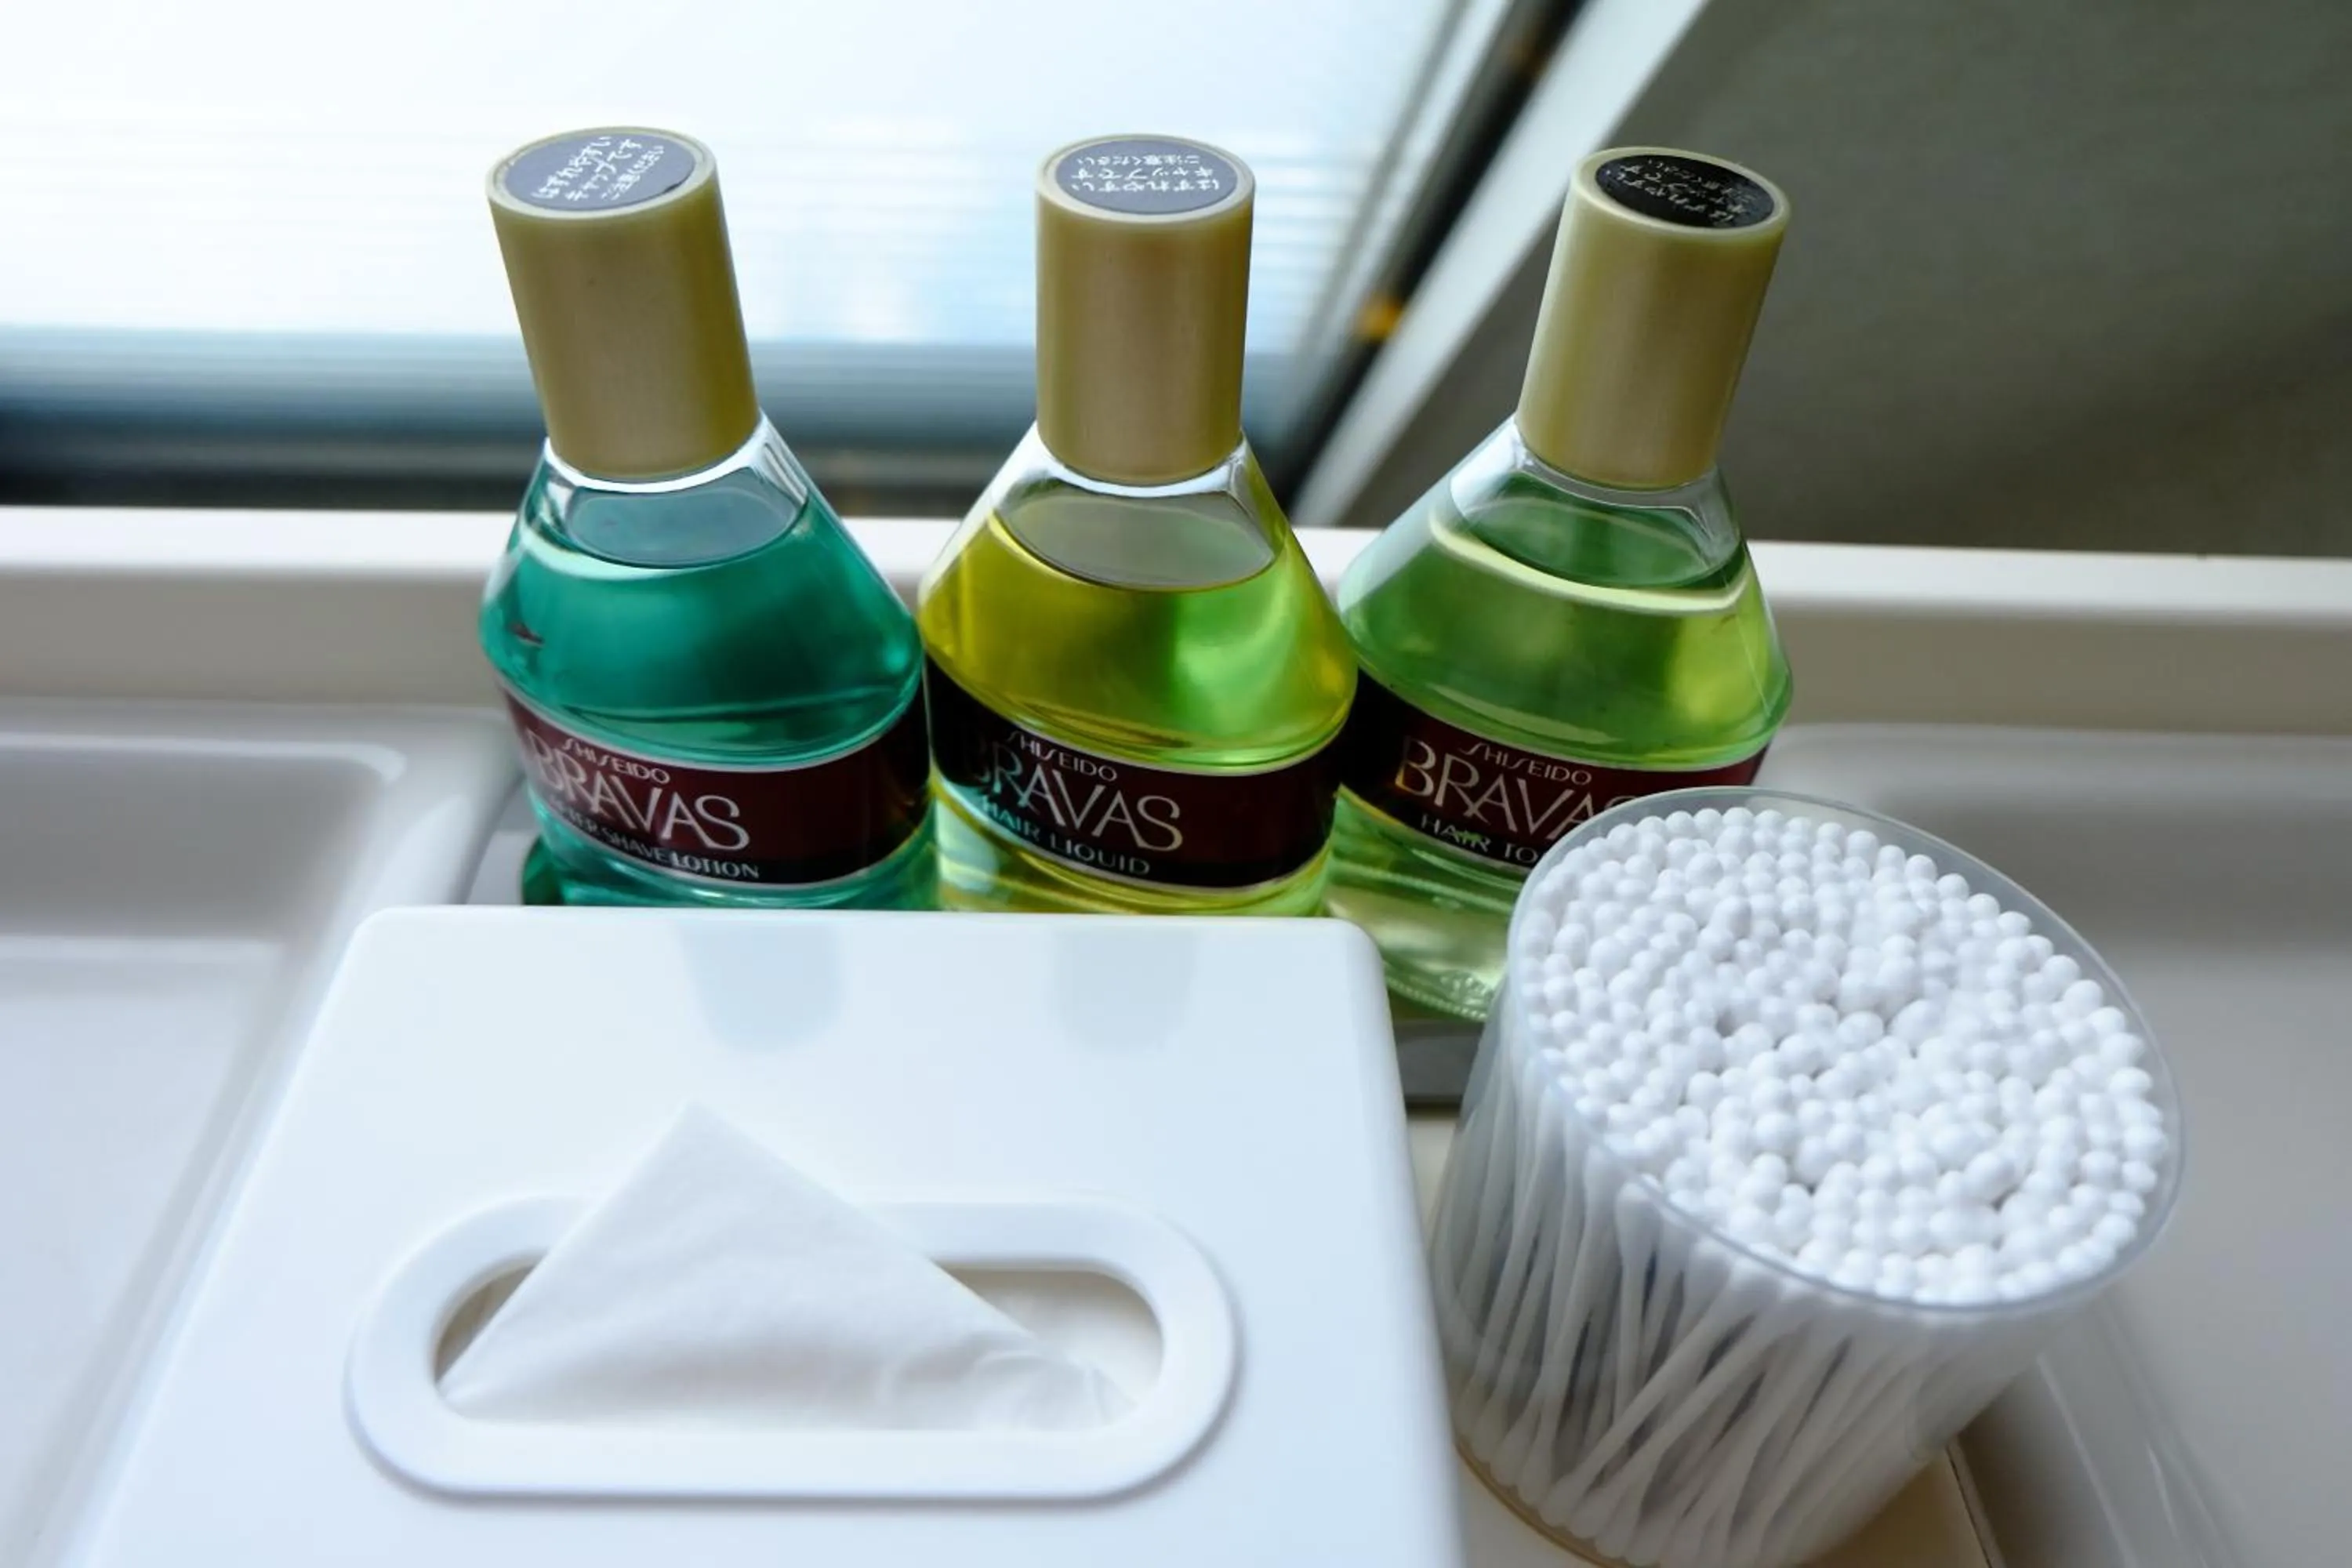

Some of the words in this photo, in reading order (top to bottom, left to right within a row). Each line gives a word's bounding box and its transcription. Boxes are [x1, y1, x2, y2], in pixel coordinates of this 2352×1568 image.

[562, 737, 671, 784] SHISEIDO
[1007, 730, 1117, 782] SHISEIDO
[1458, 742, 1592, 786] SHISEIDO
[526, 728, 750, 851] BRAVAS
[1395, 739, 1637, 840] BRAVA
[602, 827, 668, 863] SHAVE
[670, 851, 760, 879] LOTION
[982, 794, 1040, 841] HAIR
[1050, 833, 1150, 876] LIQUID
[1420, 813, 1491, 852] HAIR
